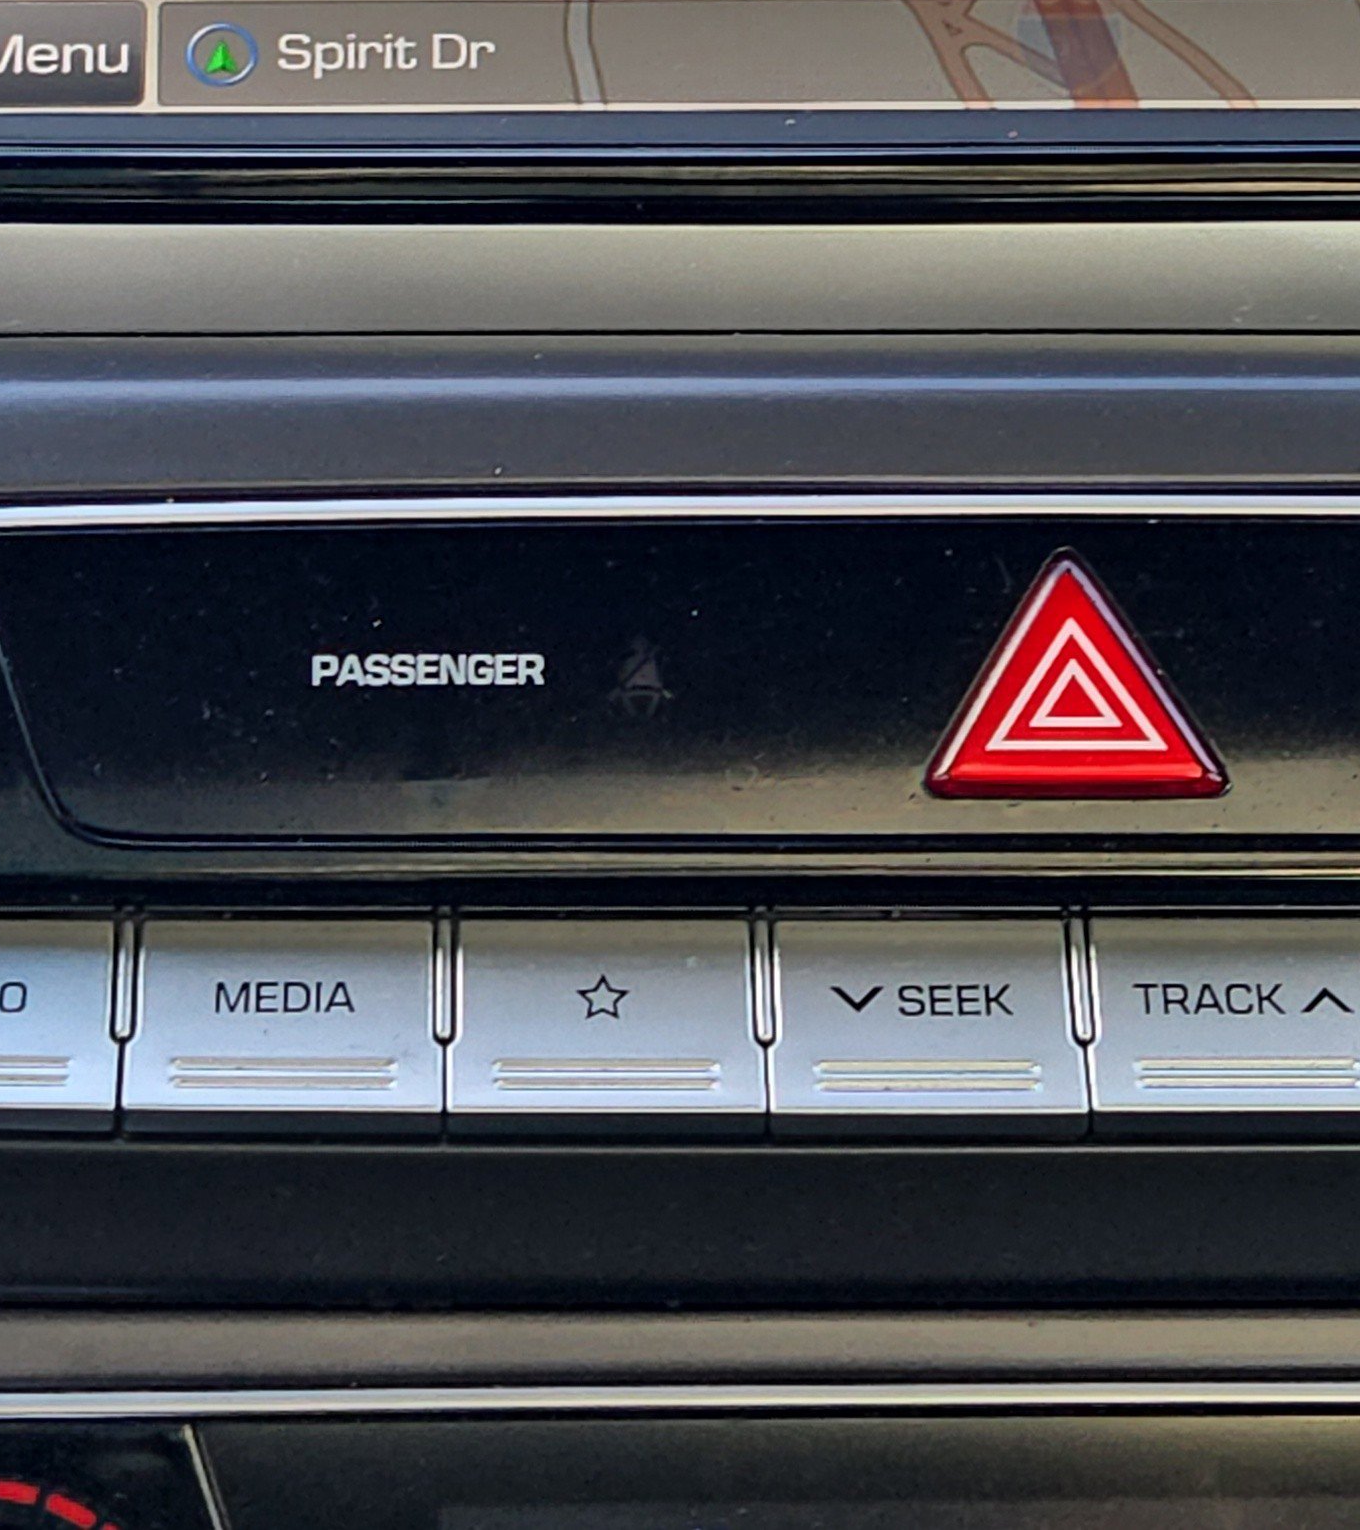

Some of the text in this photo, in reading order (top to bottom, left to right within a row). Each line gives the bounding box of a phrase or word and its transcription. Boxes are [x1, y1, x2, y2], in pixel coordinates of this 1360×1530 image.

[277, 33, 496, 79] Spirit Dr
[310, 653, 546, 687] PASSENGER
[213, 981, 356, 1014] MEDIA
[897, 983, 1015, 1016] SEEK
[1132, 983, 1287, 1016] TRACK
